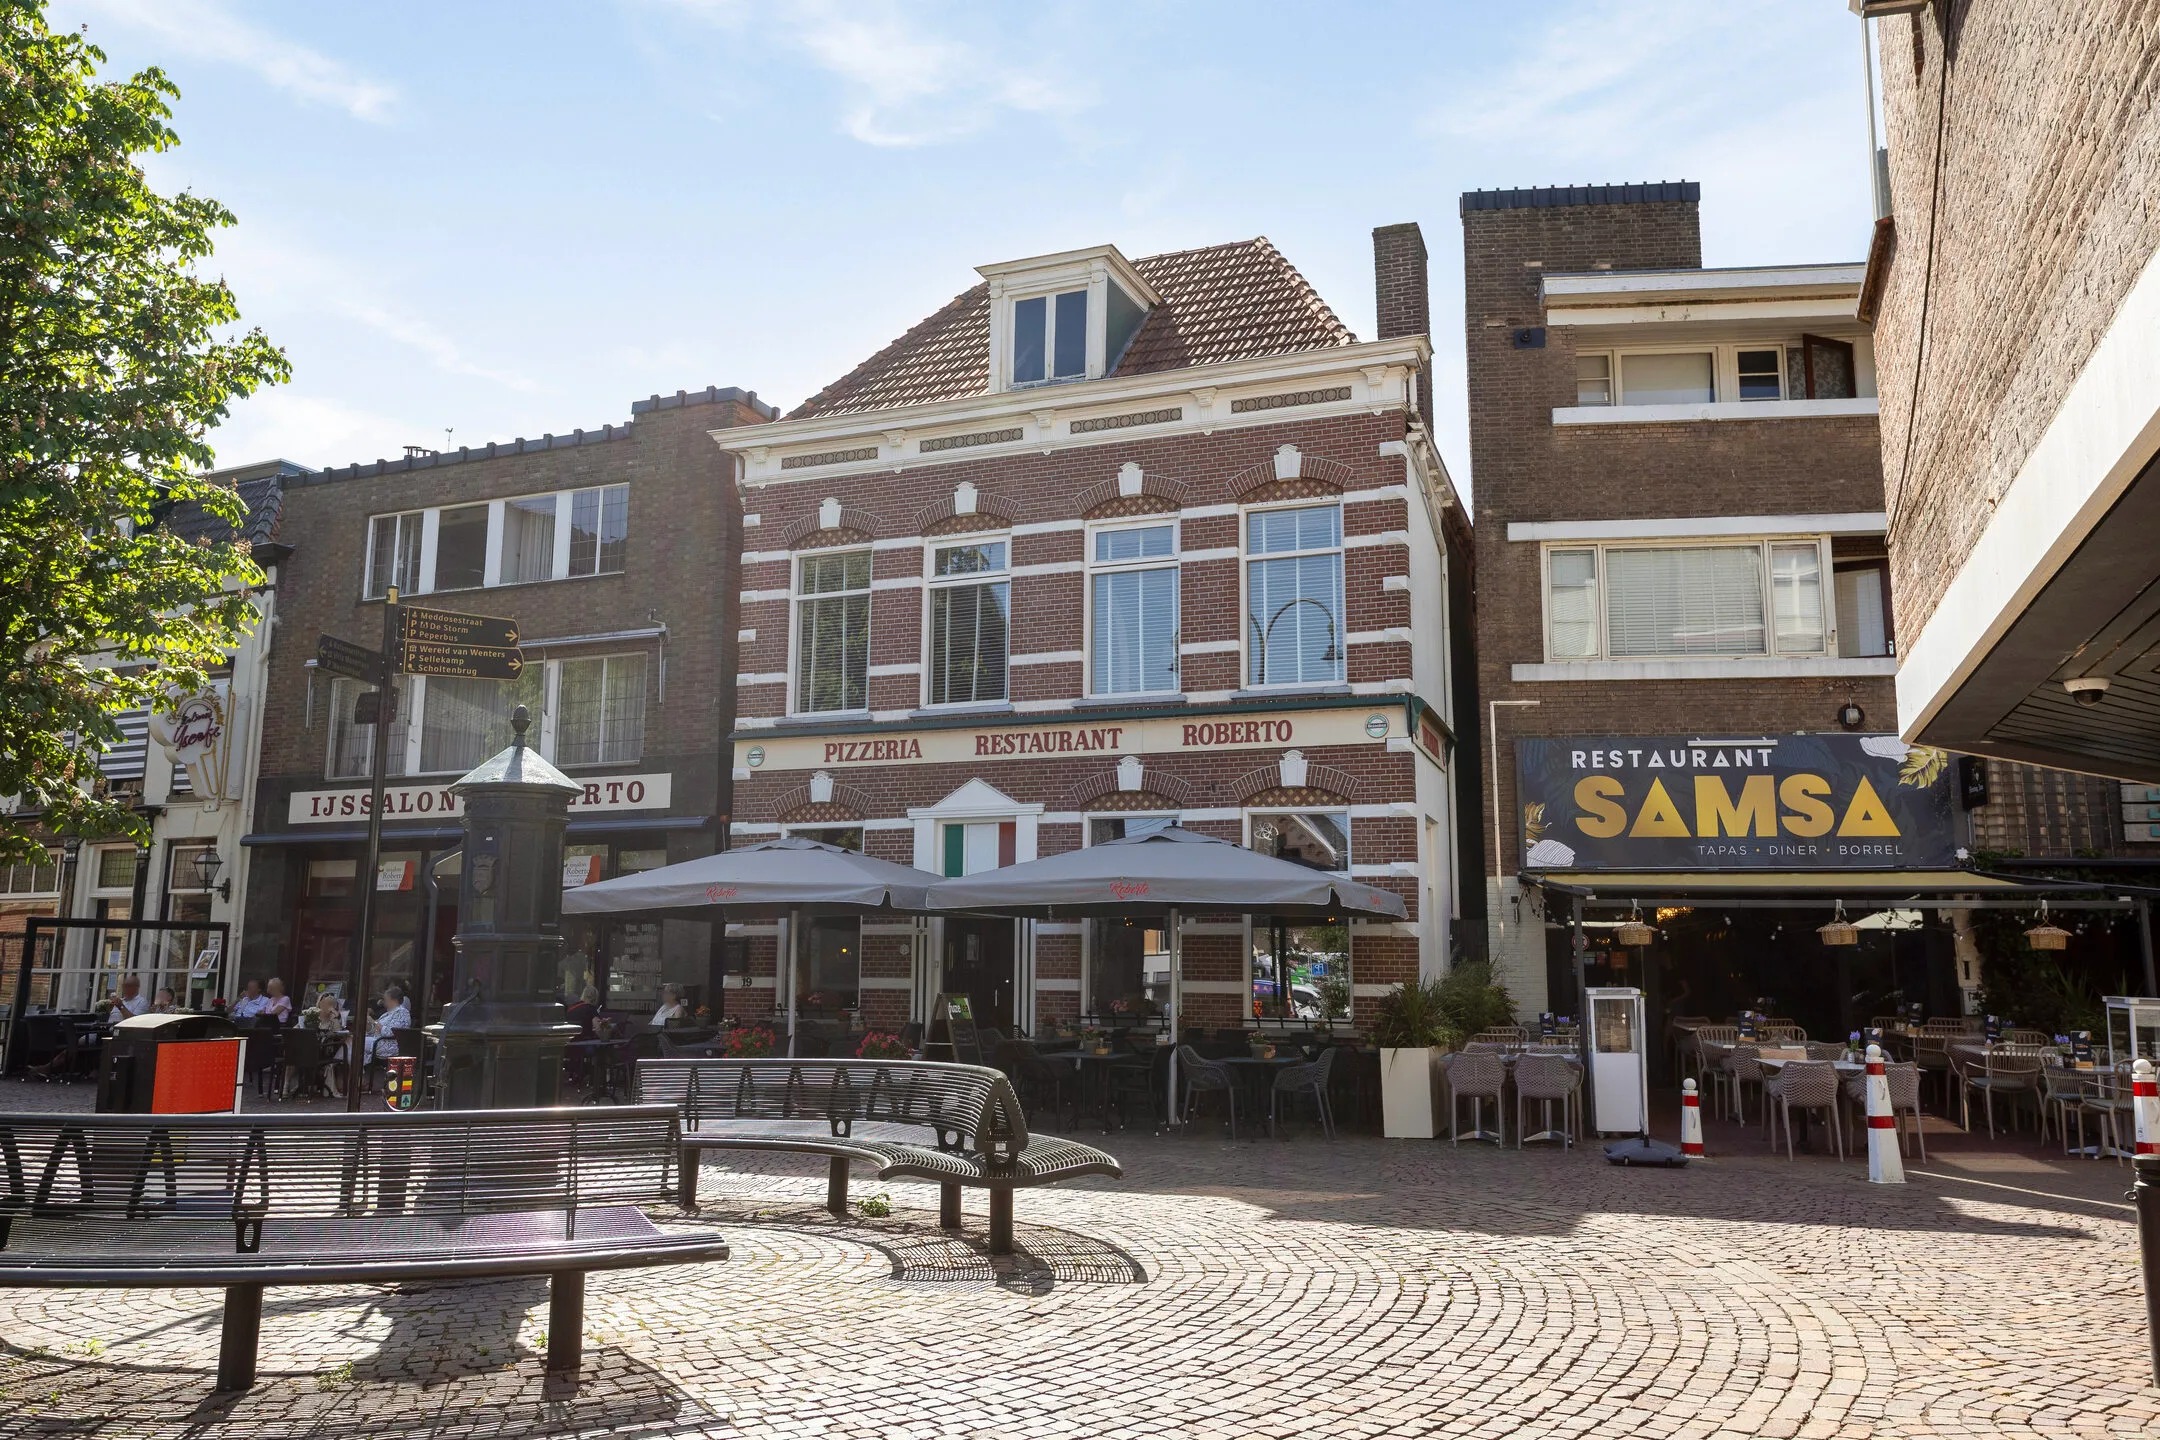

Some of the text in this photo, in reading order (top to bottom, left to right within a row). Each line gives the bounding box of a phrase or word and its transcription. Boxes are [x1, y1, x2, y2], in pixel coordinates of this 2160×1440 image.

[420, 612, 483, 626] Meddosestraat
[410, 629, 458, 641] P Peperbus
[444, 624, 469, 634] Storm
[420, 645, 450, 654] Wereld
[470, 648, 505, 658] Wenters
[419, 654, 464, 665] Sellekamp
[418, 665, 477, 676] Scholtenbrug
[824, 719, 1293, 763] PIZZERIA RESTAURANT ROBERTO
[1571, 749, 1773, 769] RESTAURANT
[310, 791, 456, 817] IJSSALON
[1573, 774, 1902, 838] SAMSA
[1698, 845, 1903, 855] TAPAS DINER BORREL
[742, 976, 753, 987] 19
